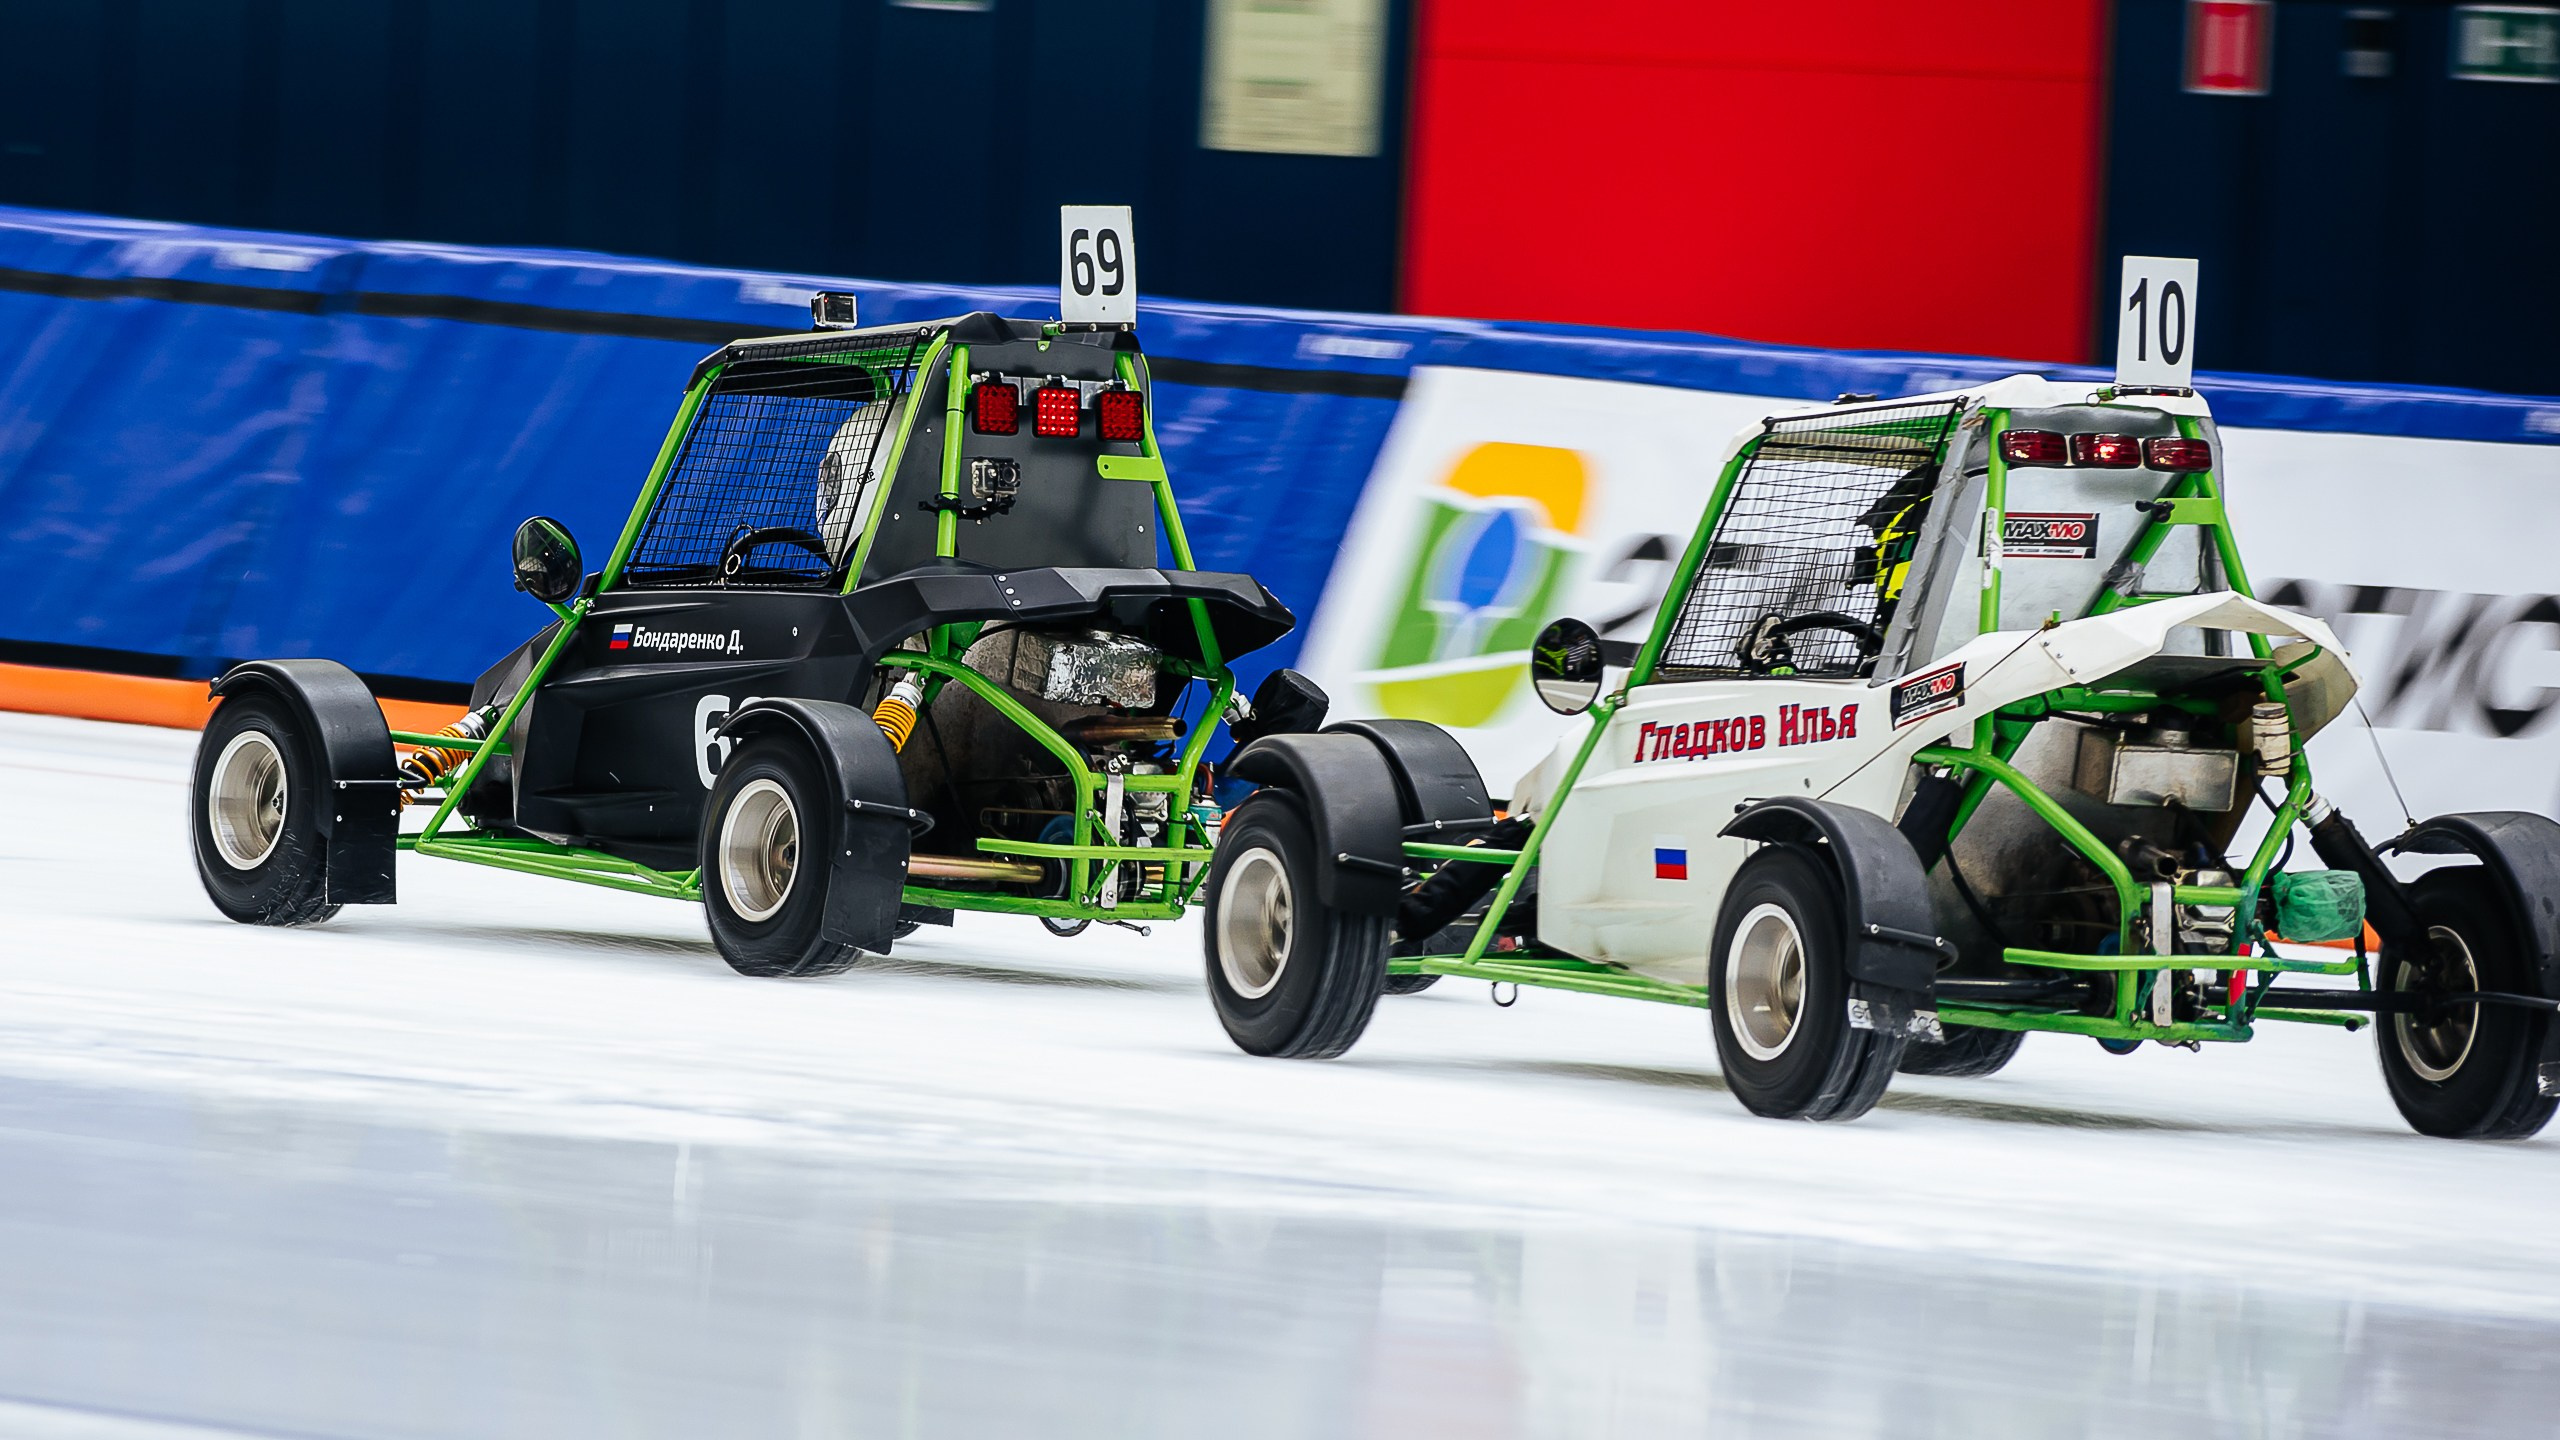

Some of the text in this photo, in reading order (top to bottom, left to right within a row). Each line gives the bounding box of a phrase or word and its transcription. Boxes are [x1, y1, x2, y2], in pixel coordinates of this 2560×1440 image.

[1069, 228, 1124, 296] 69
[2128, 277, 2186, 366] 10
[2002, 521, 2086, 540] MAXMO
[633, 626, 744, 655] Бондаренко Д.
[694, 694, 763, 790] 6
[1633, 715, 1766, 763] Гладков
[1778, 703, 1860, 747] Илья
